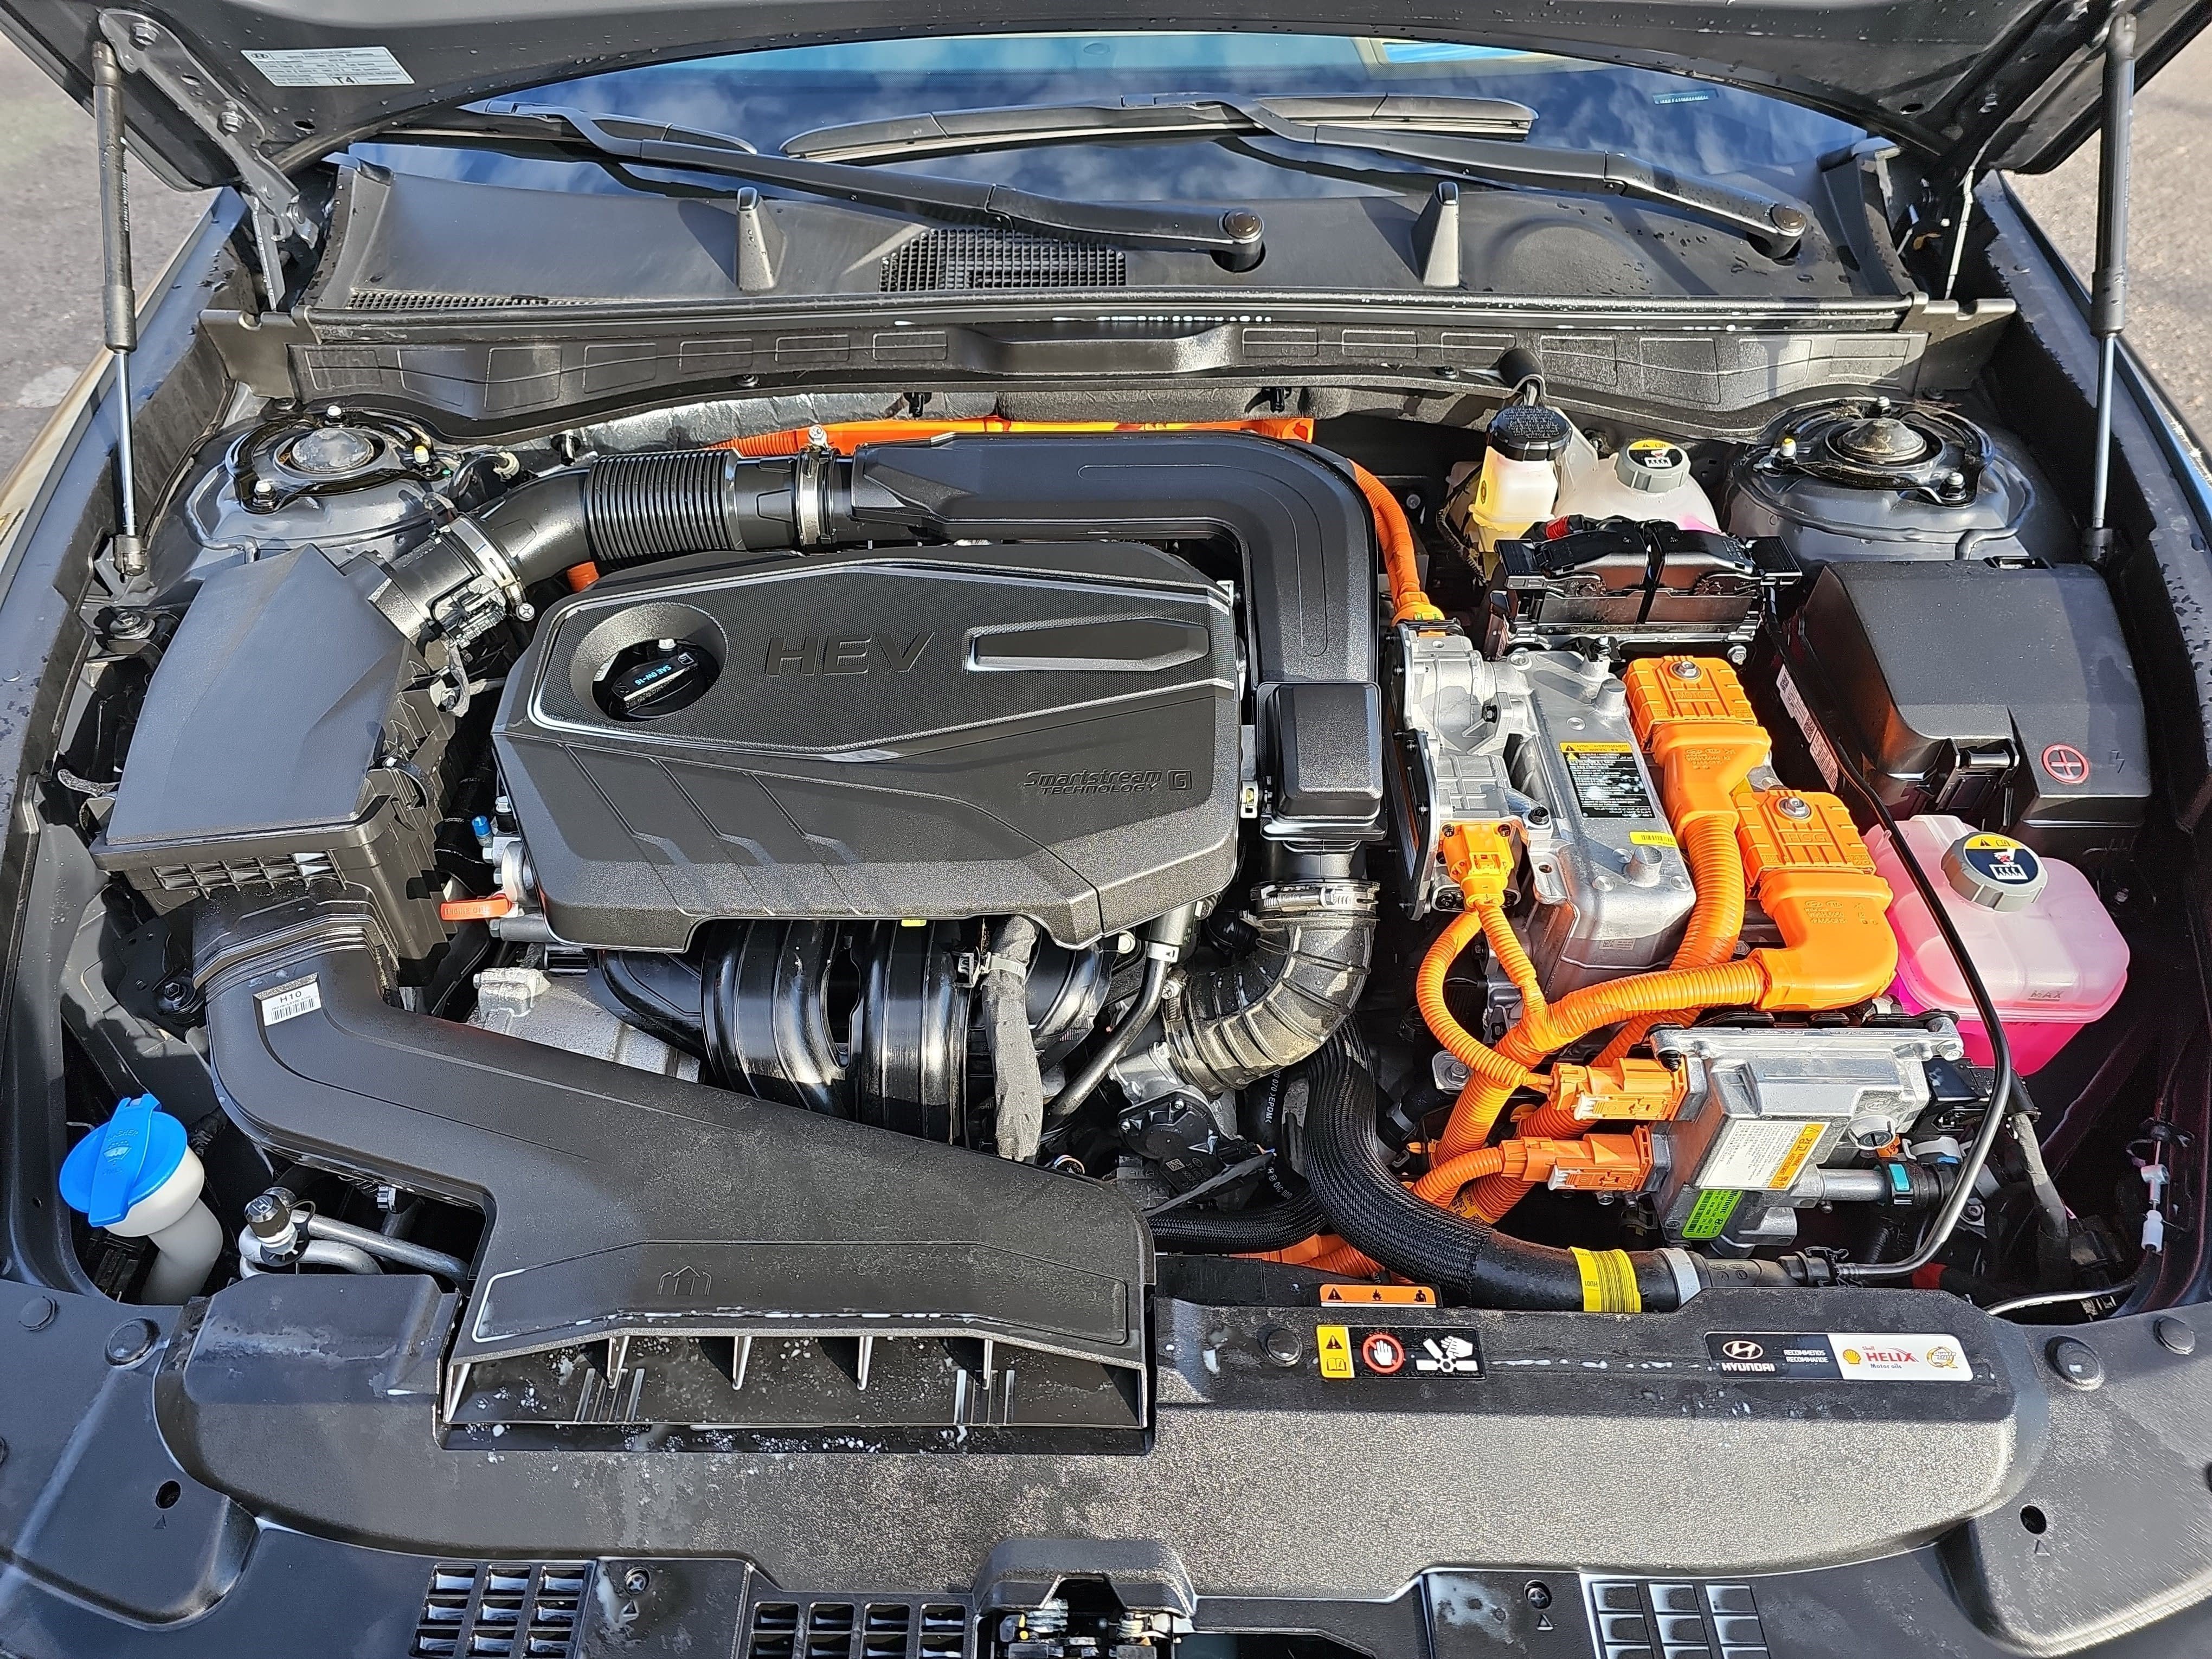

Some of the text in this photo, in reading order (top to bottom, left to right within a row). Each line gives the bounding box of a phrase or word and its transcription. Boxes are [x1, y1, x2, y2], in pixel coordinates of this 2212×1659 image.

[766, 631, 935, 677] HEV
[634, 664, 672, 686] SAE 0W-16
[1024, 769, 1162, 786] Smartstream
[1040, 782, 1159, 795] TECHNOLOGY
[1786, 833, 1827, 843] HSG
[445, 907, 470, 916] ENGINE
[280, 991, 302, 1003] H10
[2031, 990, 2064, 999] MAX
[252, 1198, 272, 1214] H
[1864, 1352, 1917, 1362] HELIX
[1721, 1362, 1776, 1372] HYUNDAI
